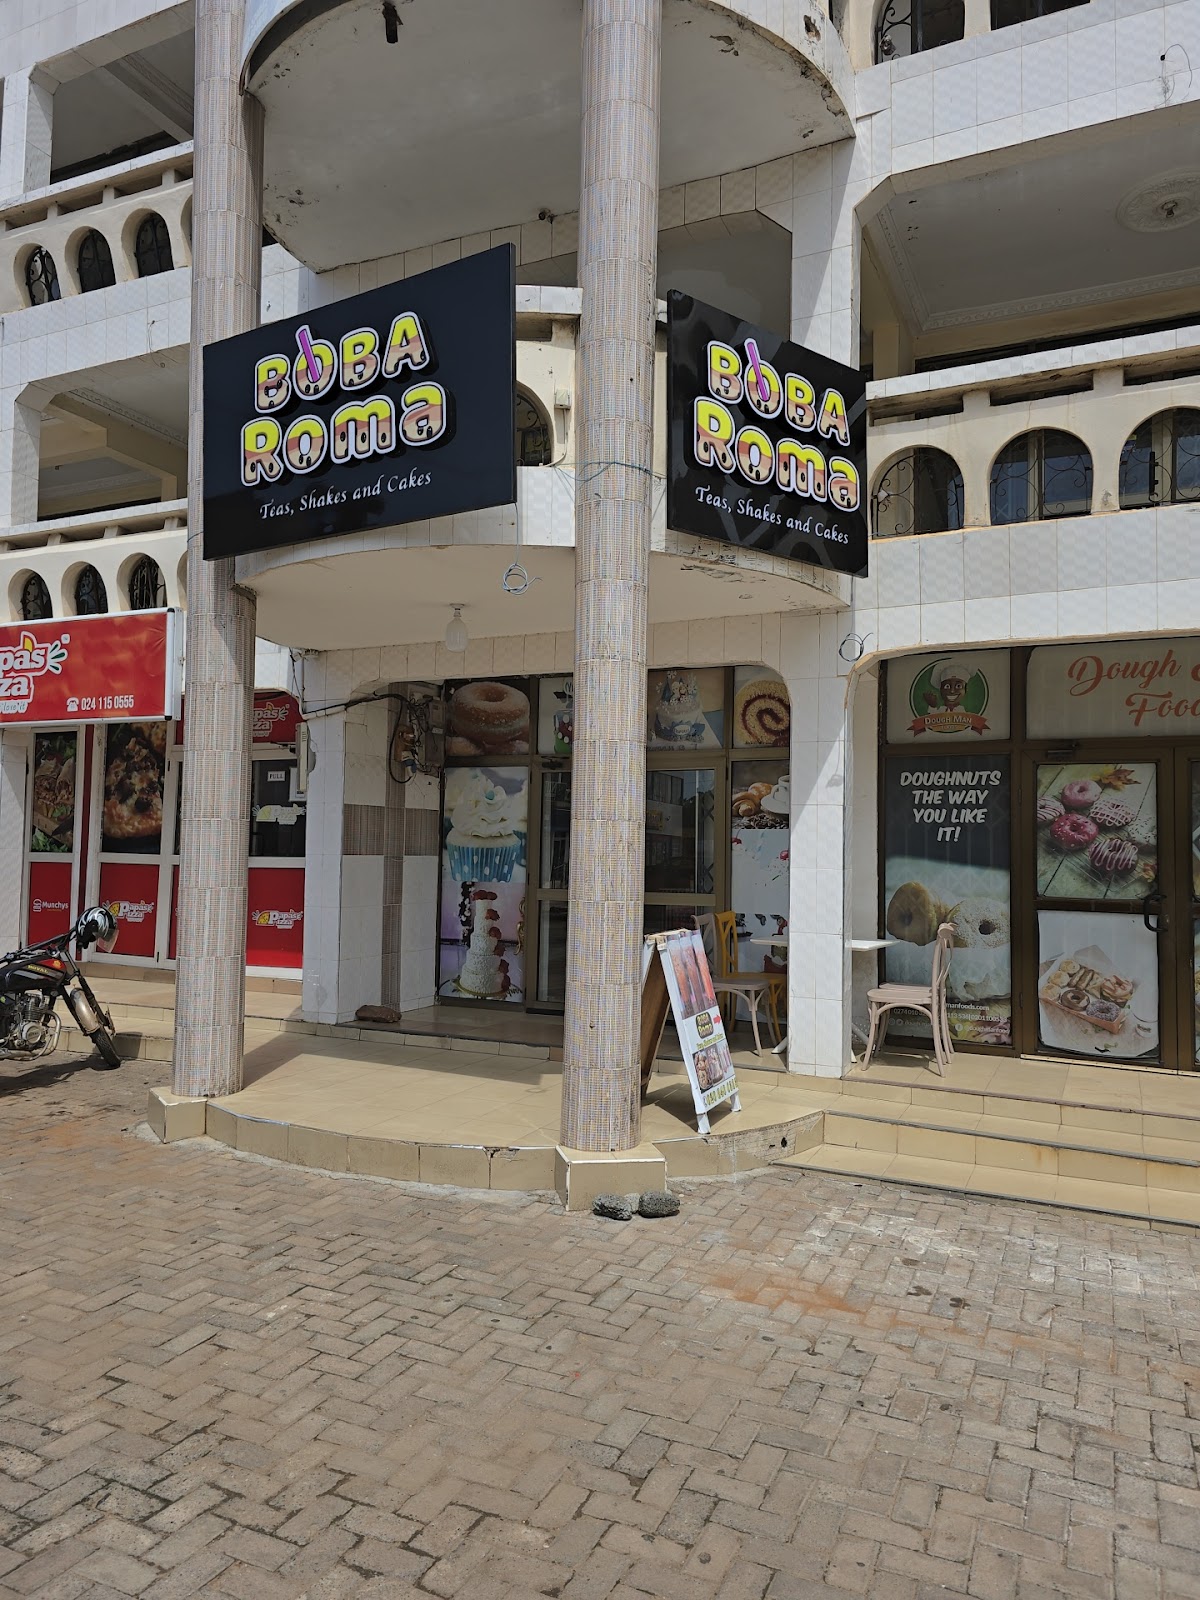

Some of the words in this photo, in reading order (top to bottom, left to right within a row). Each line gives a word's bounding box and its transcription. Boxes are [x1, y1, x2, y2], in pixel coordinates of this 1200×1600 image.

[255, 311, 430, 414] BOBA
[707, 338, 850, 446] BOBA
[259, 499, 294, 520] Teas,
[299, 485, 347, 511] Shakes
[352, 474, 385, 500] and
[387, 466, 432, 493] Cakes
[695, 485, 732, 513] Teas,
[736, 499, 782, 525] Shakes
[786, 516, 813, 533] and
[815, 522, 849, 545] Cakes
[0, 648, 46, 678] pas
[1067, 649, 1182, 697] Dough
[0, 675, 29, 697] za
[81, 697, 96, 711] 024
[98, 696, 112, 709] 115
[114, 694, 134, 709] 0555
[900, 770, 1002, 786] DOUGHNUTS
[912, 790, 944, 805] THE
[948, 790, 989, 805] WAY
[913, 808, 947, 823] YOU
[951, 808, 988, 823] LIKE
[937, 826, 961, 842] IT!
[42, 901, 69, 911] Munchys
